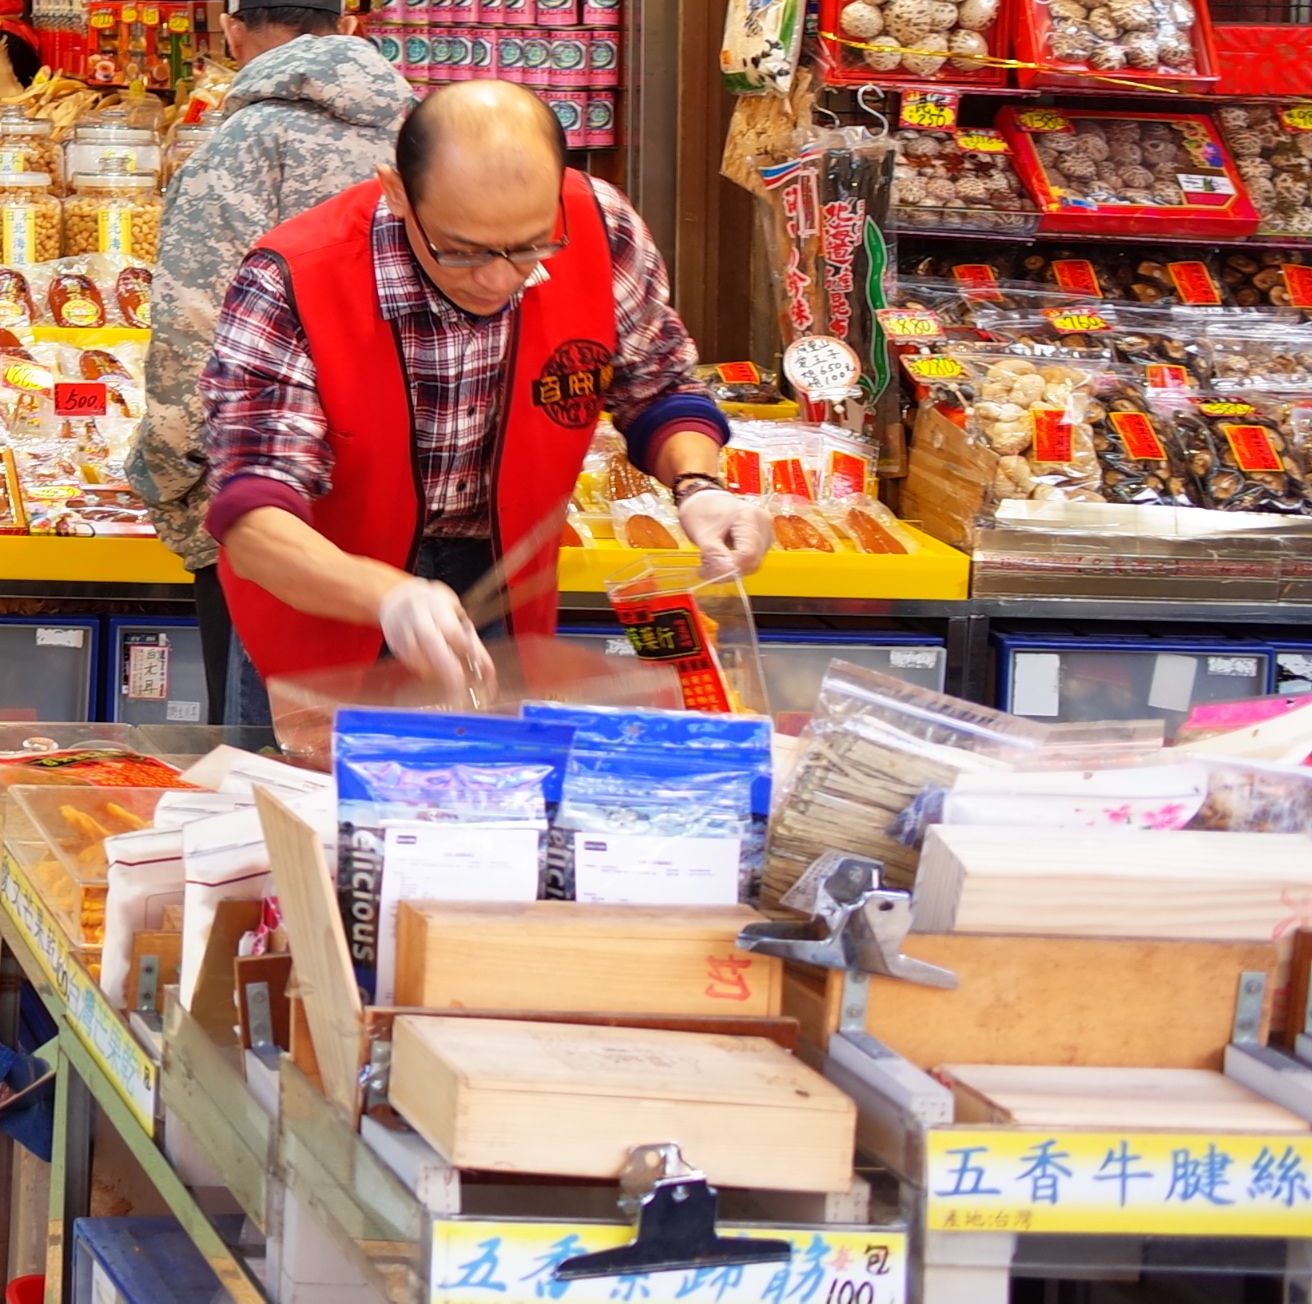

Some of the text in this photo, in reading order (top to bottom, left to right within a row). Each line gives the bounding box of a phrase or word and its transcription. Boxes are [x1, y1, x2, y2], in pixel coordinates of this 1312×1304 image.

[901, 317, 932, 335] 880
[936, 1138, 1311, 1208] 五香牛腱絲
